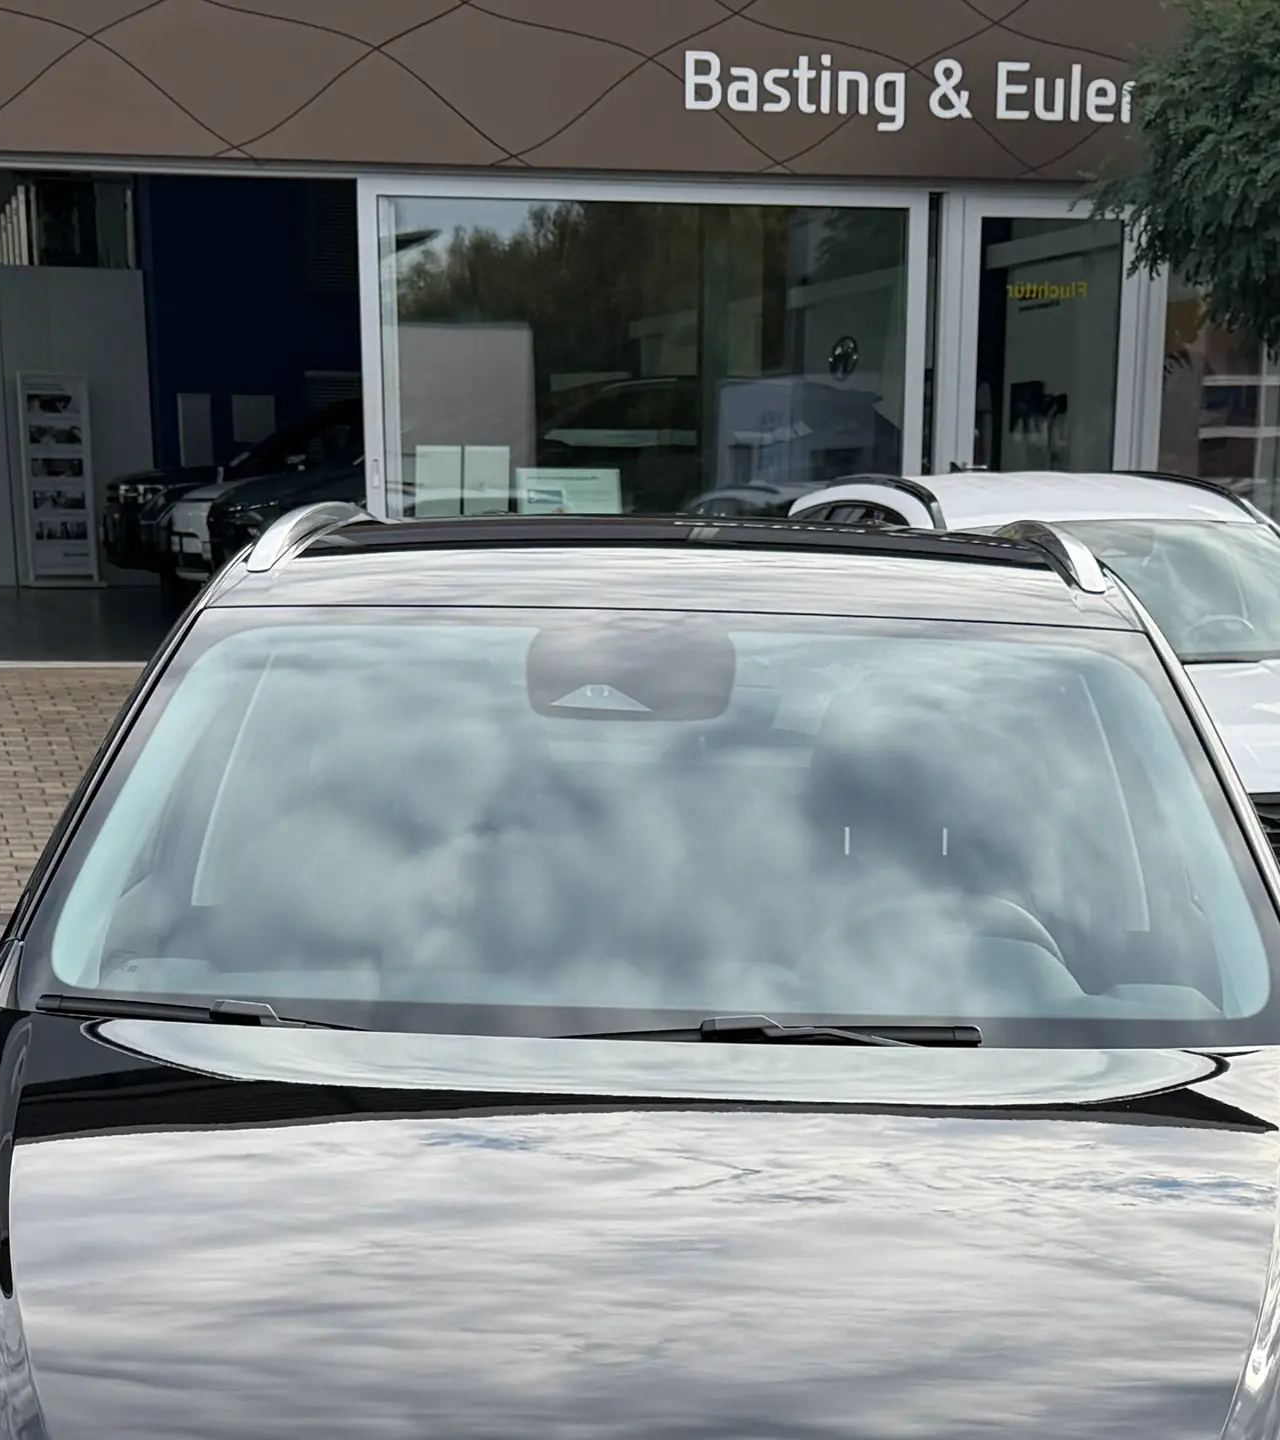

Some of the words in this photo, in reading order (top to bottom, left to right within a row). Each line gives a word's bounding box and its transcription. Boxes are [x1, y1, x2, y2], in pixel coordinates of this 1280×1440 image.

[684, 50, 906, 132] Basting
[928, 58, 973, 119] &
[996, 60, 1137, 124] Euler
